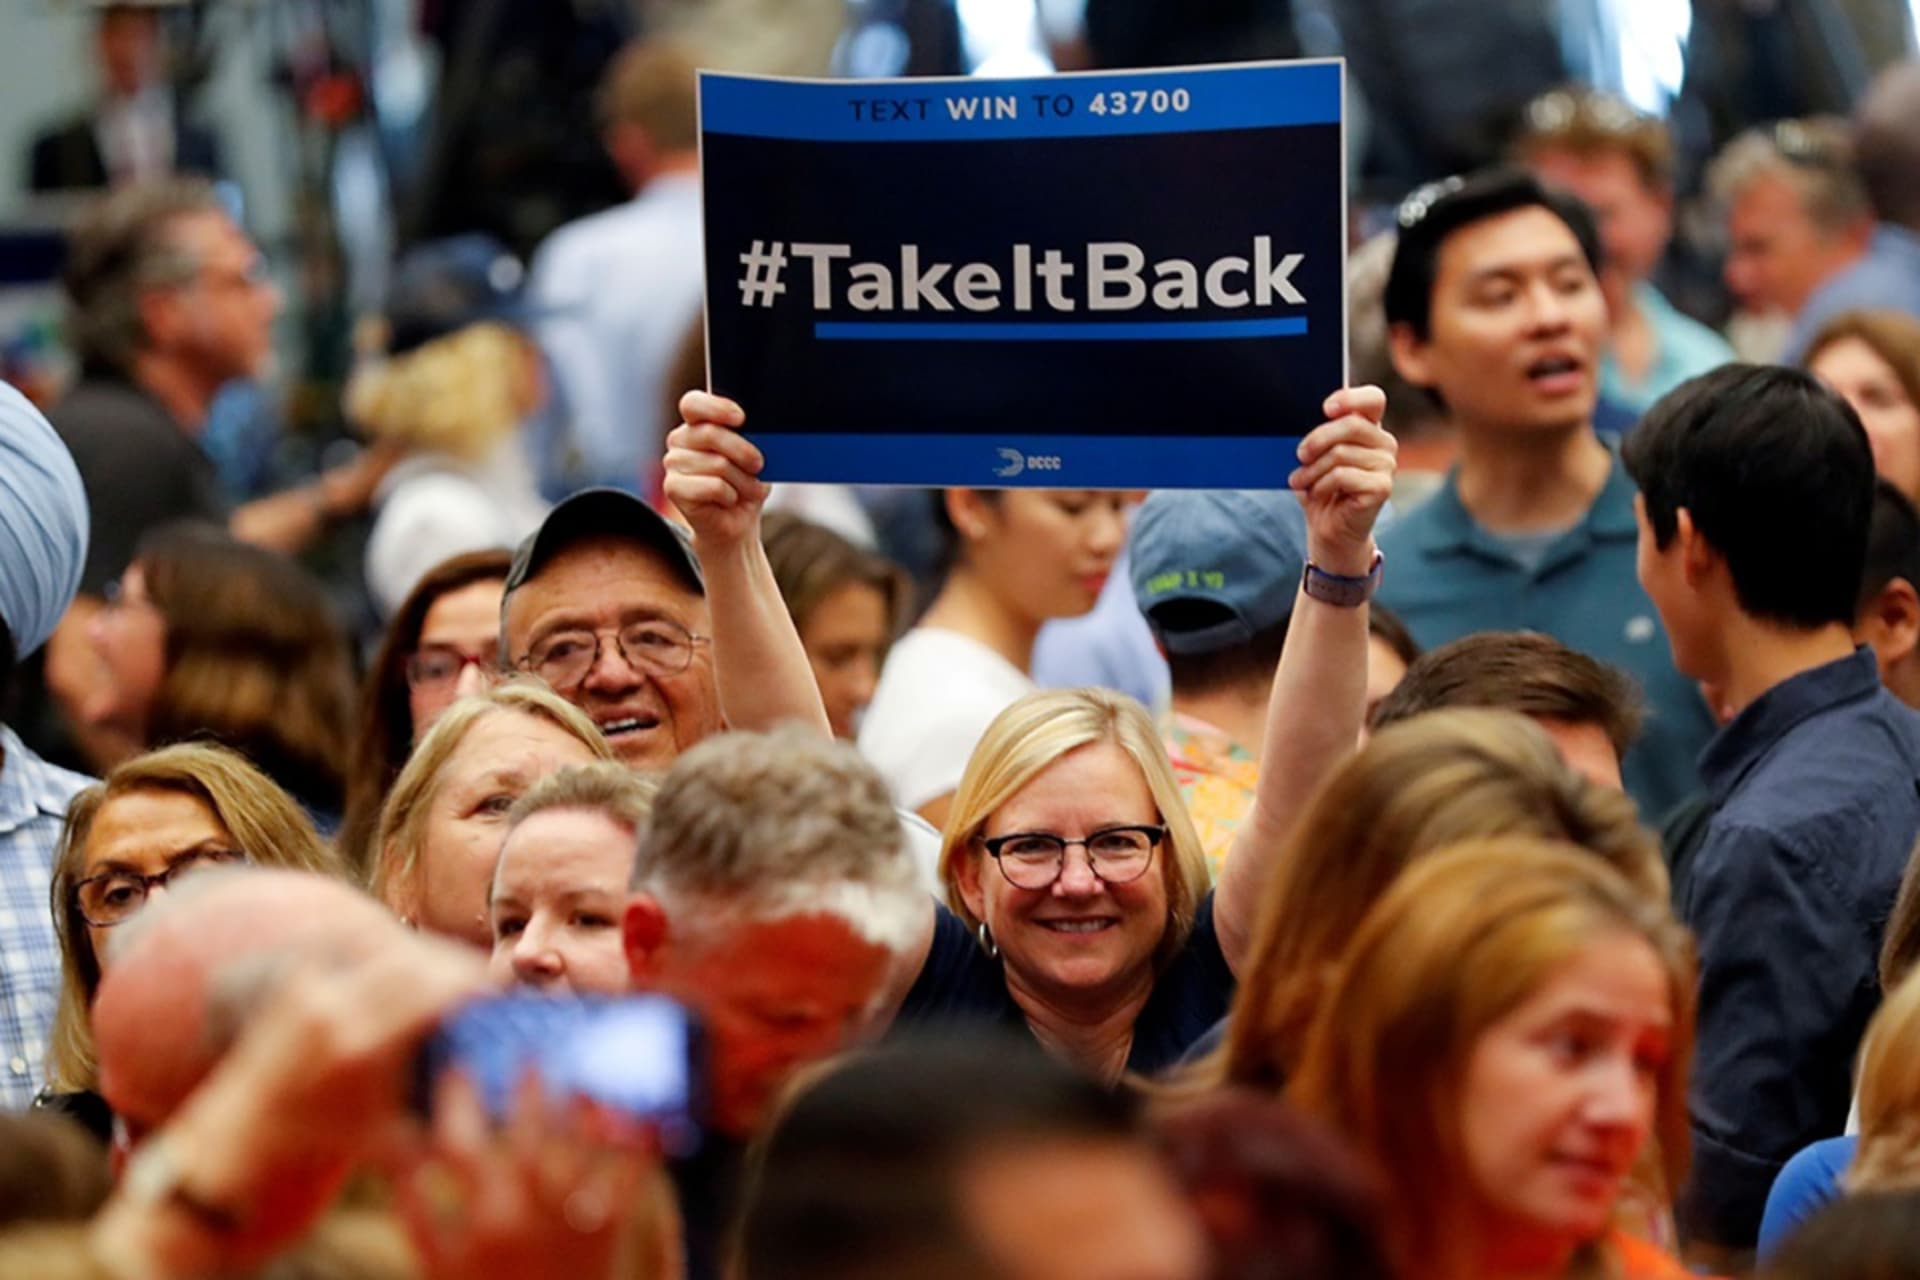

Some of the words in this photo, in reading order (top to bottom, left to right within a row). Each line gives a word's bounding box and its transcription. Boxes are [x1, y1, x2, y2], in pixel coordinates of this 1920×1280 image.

[850, 98, 931, 122] TEXT
[945, 96, 1018, 120] WIN
[1033, 94, 1074, 118] TO
[1088, 88, 1191, 116] 43700
[738, 235, 1307, 311] #TakeItBack
[1027, 455, 1062, 470] DCCC
